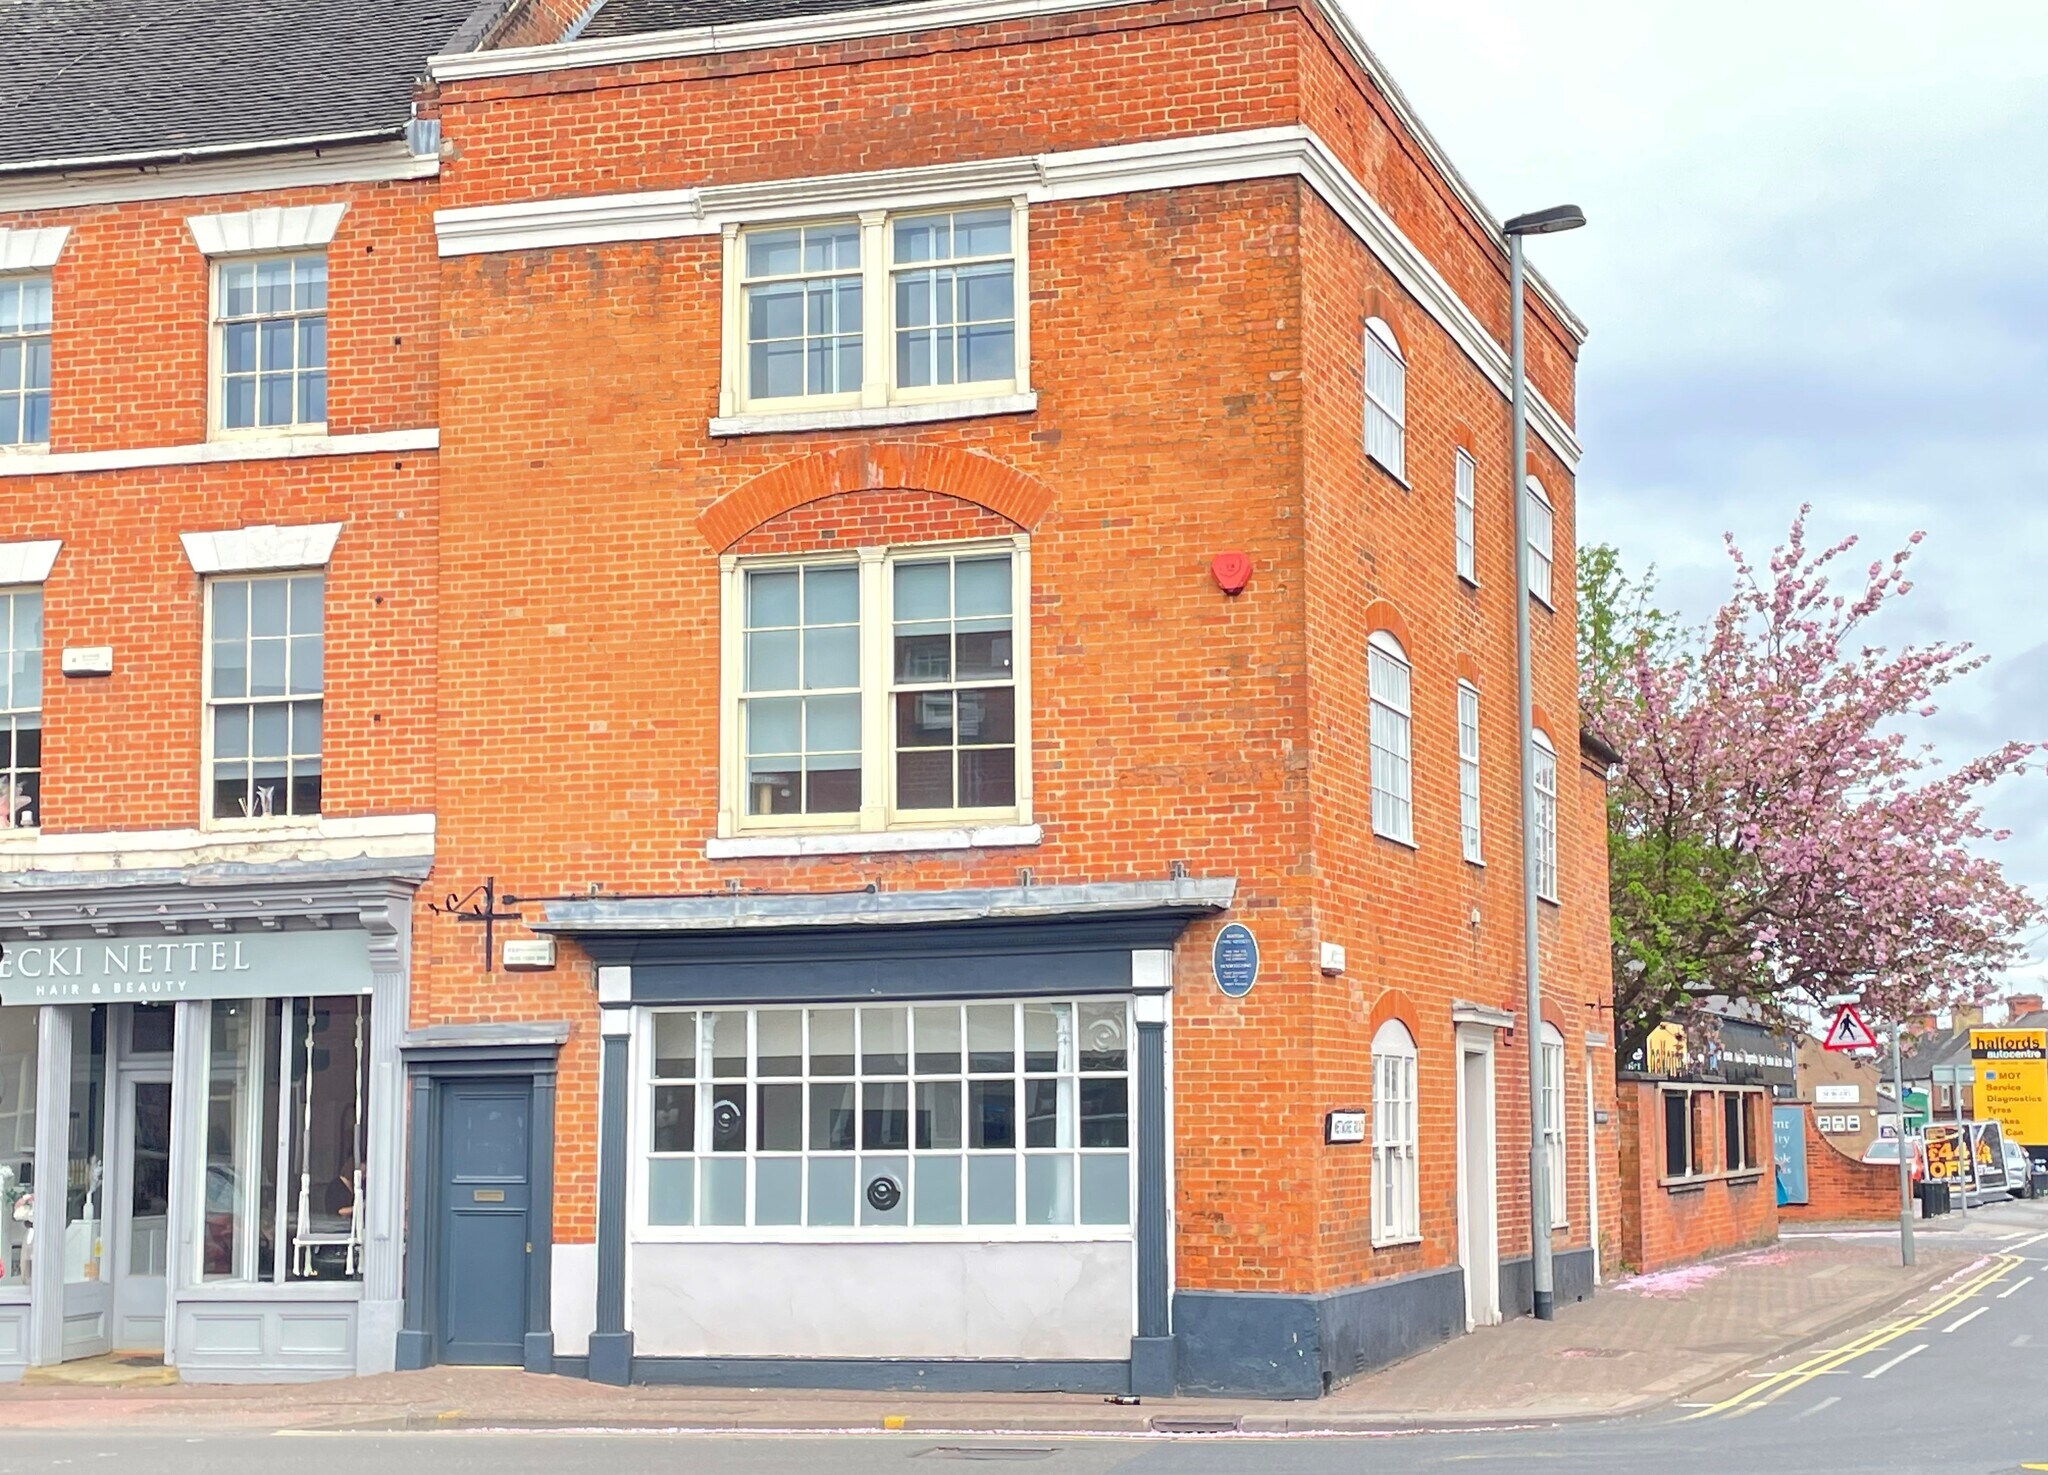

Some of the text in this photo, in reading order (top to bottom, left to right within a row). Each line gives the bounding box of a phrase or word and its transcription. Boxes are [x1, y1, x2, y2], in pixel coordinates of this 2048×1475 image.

[103, 941, 250, 975] NETTEL
[36, 980, 187, 996] HAIR & BEAUTY
[1976, 1036, 2040, 1050] halfords
[1987, 1050, 2041, 1059] autocentre
[1998, 1072, 2021, 1080] MOT
[1986, 1083, 2021, 1091] Service
[1987, 1095, 2042, 1104] Diagnostics
[1987, 1106, 2012, 1114] Tyres
[1929, 1159, 1971, 1178] OFF
